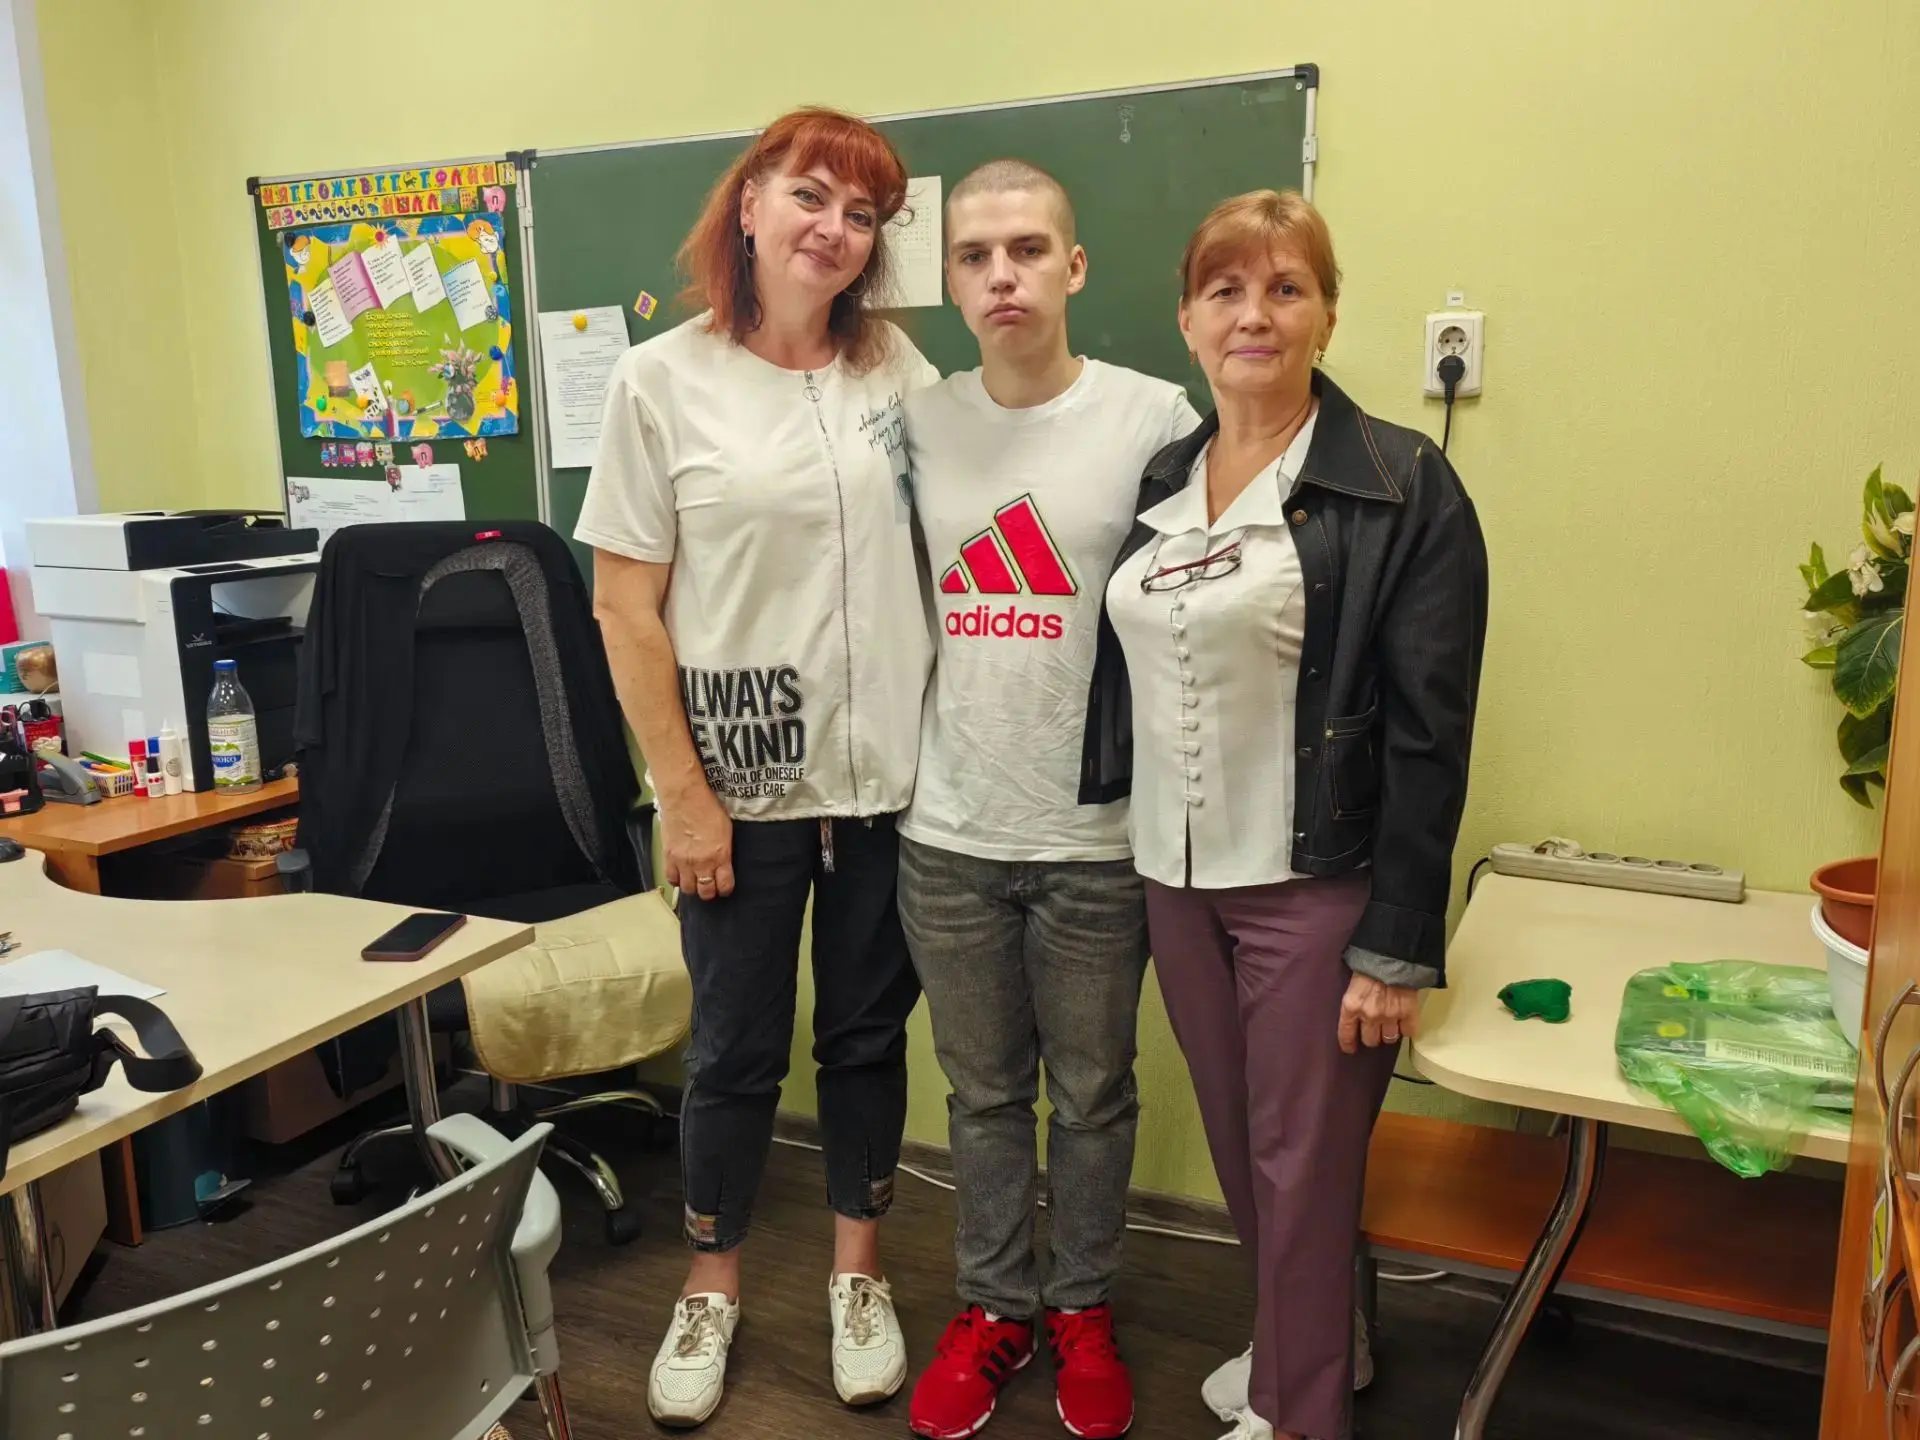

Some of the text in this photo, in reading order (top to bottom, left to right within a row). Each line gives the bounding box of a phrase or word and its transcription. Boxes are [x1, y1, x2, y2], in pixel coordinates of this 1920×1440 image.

[946, 605, 1063, 640] adidas
[692, 719, 806, 769] E KIND
[750, 770, 763, 783] OF
[765, 766, 804, 781] ONESELF
[739, 784, 762, 799] SELF
[763, 783, 786, 797] CARE
